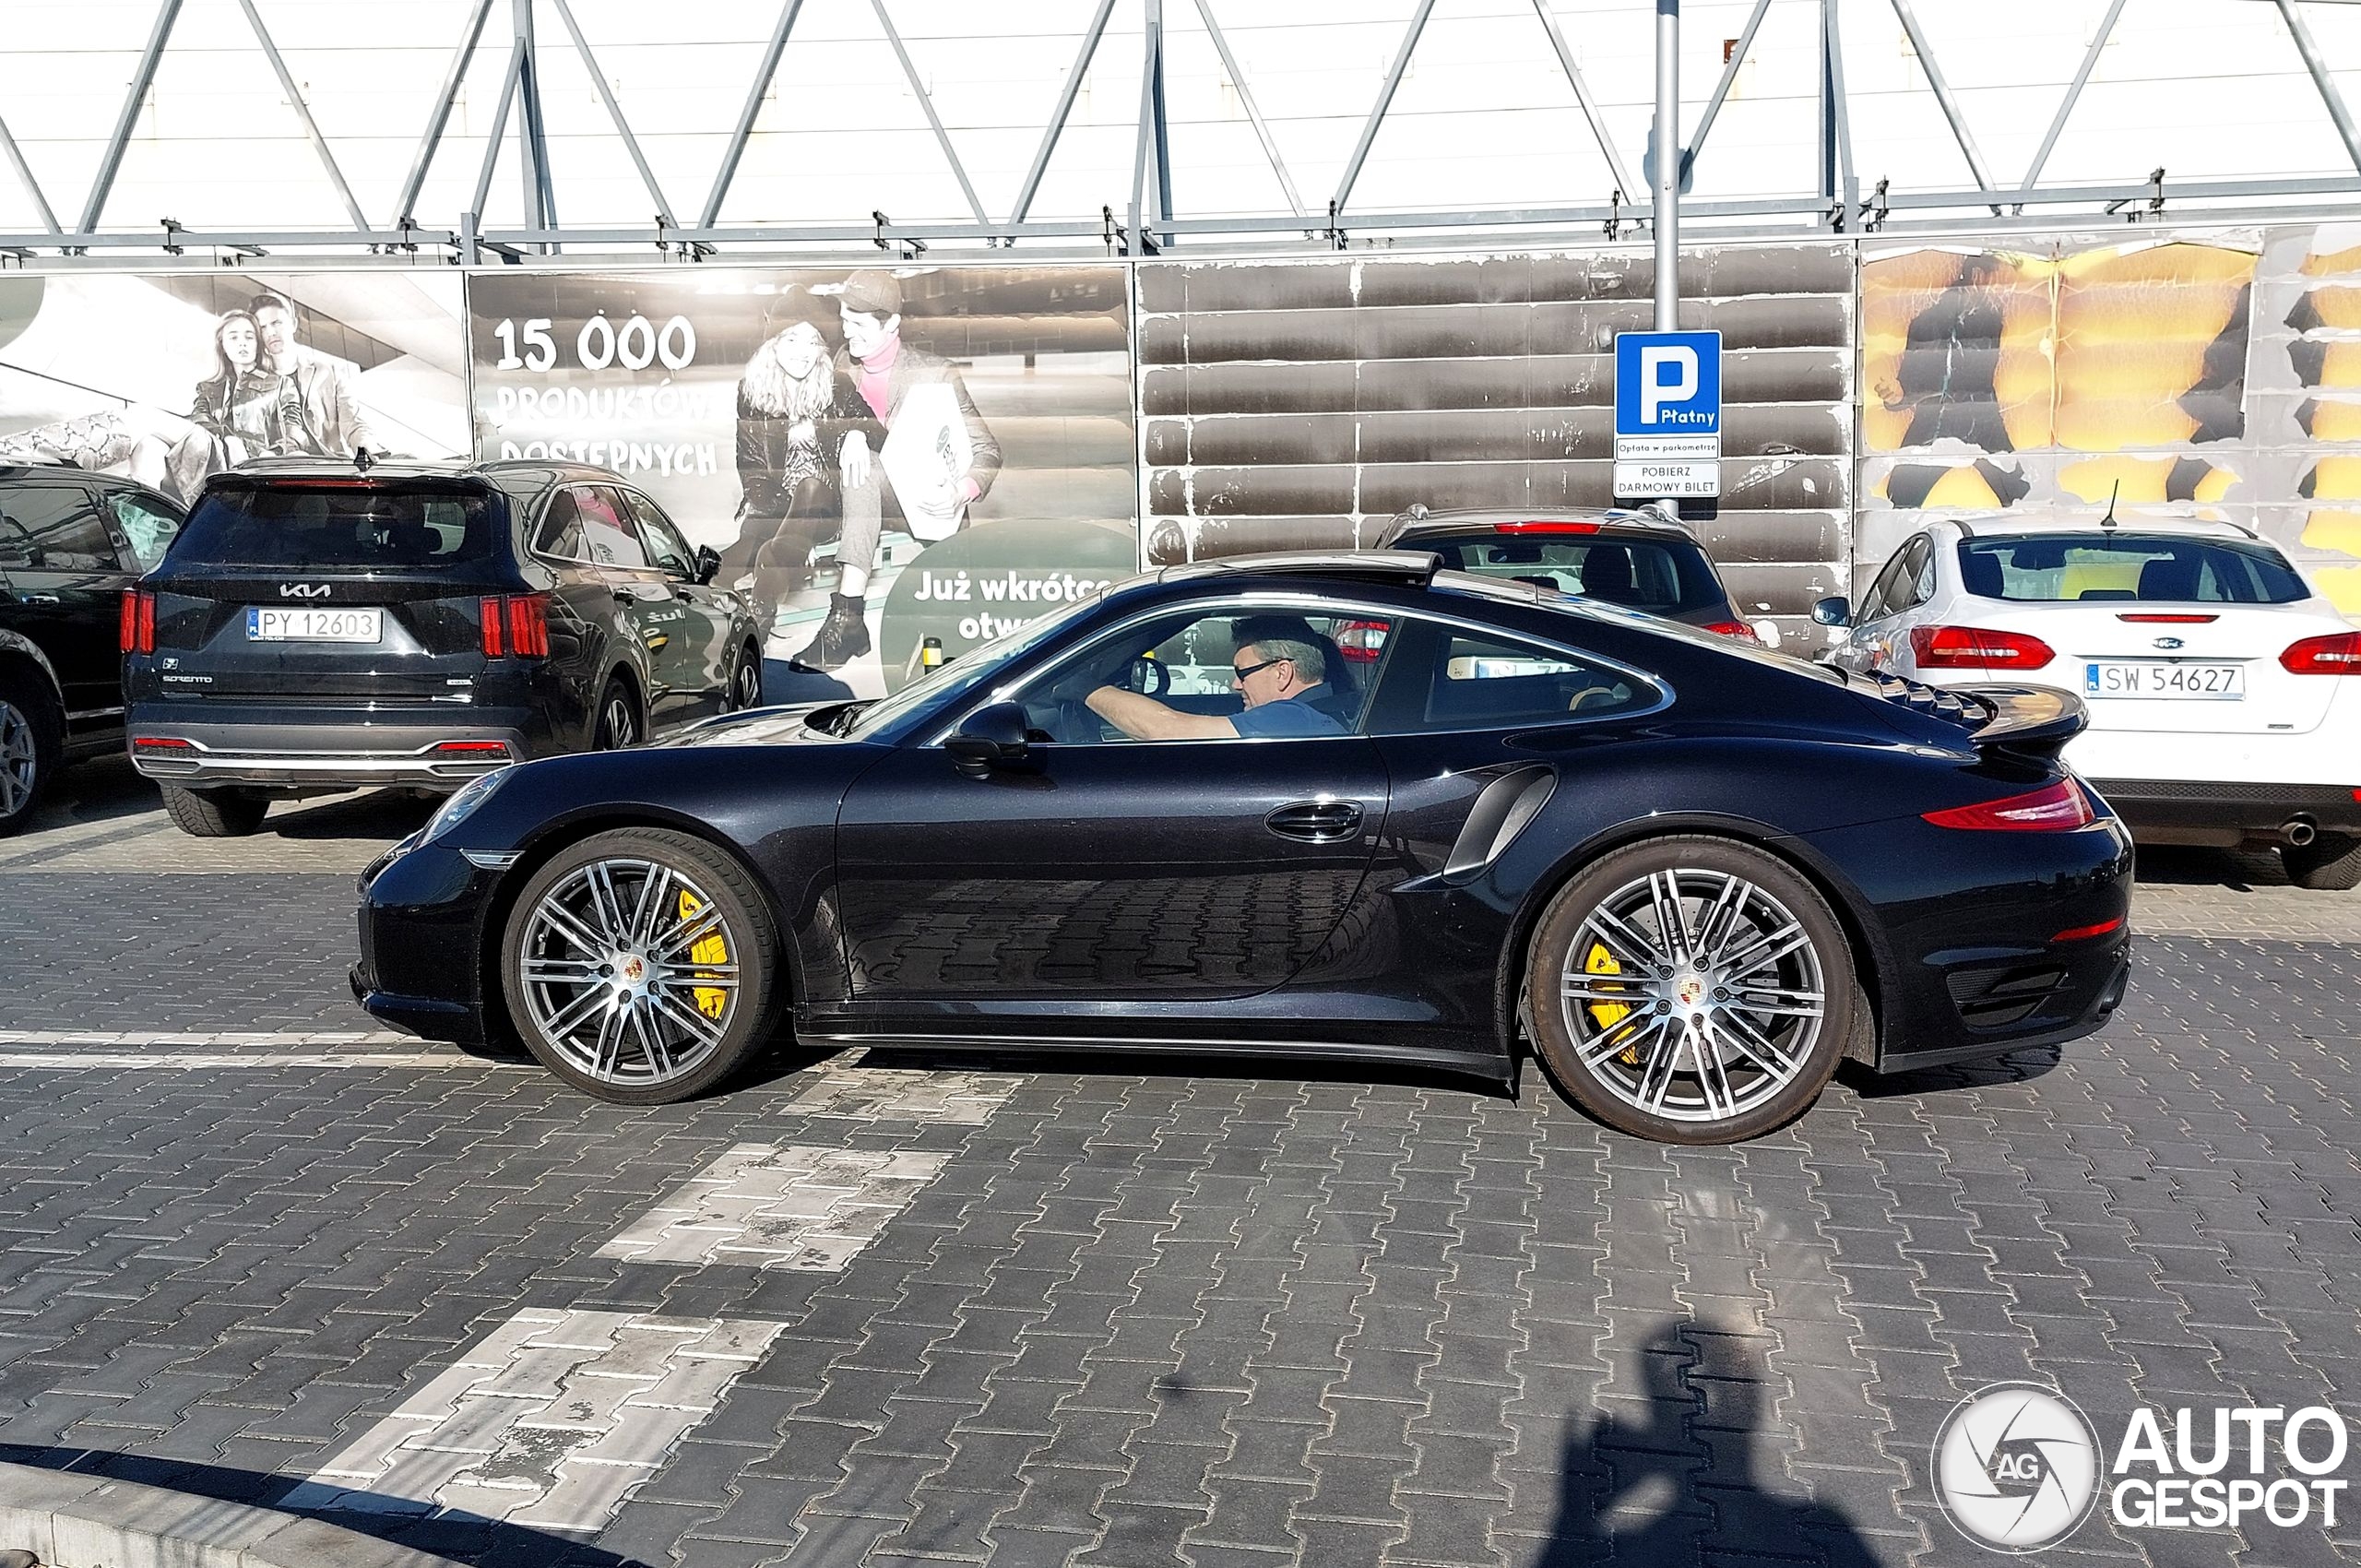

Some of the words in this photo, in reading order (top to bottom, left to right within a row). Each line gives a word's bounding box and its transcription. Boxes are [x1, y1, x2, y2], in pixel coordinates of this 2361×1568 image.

[493, 317, 557, 373] 15
[576, 315, 696, 371] 000
[1641, 345, 1699, 424] P
[1661, 409, 1715, 427] Płatny
[1619, 445, 1650, 454] Opłata
[1663, 444, 1716, 453] parkometrze
[1642, 467, 1691, 477] POBIERZ
[1619, 482, 1680, 493] DARMOWY
[1685, 481, 1715, 493] BILET
[914, 570, 971, 600] Już
[263, 612, 292, 635] PY
[303, 613, 373, 636] 12603
[2106, 668, 2140, 691] SW
[2153, 668, 2236, 692] 54627
